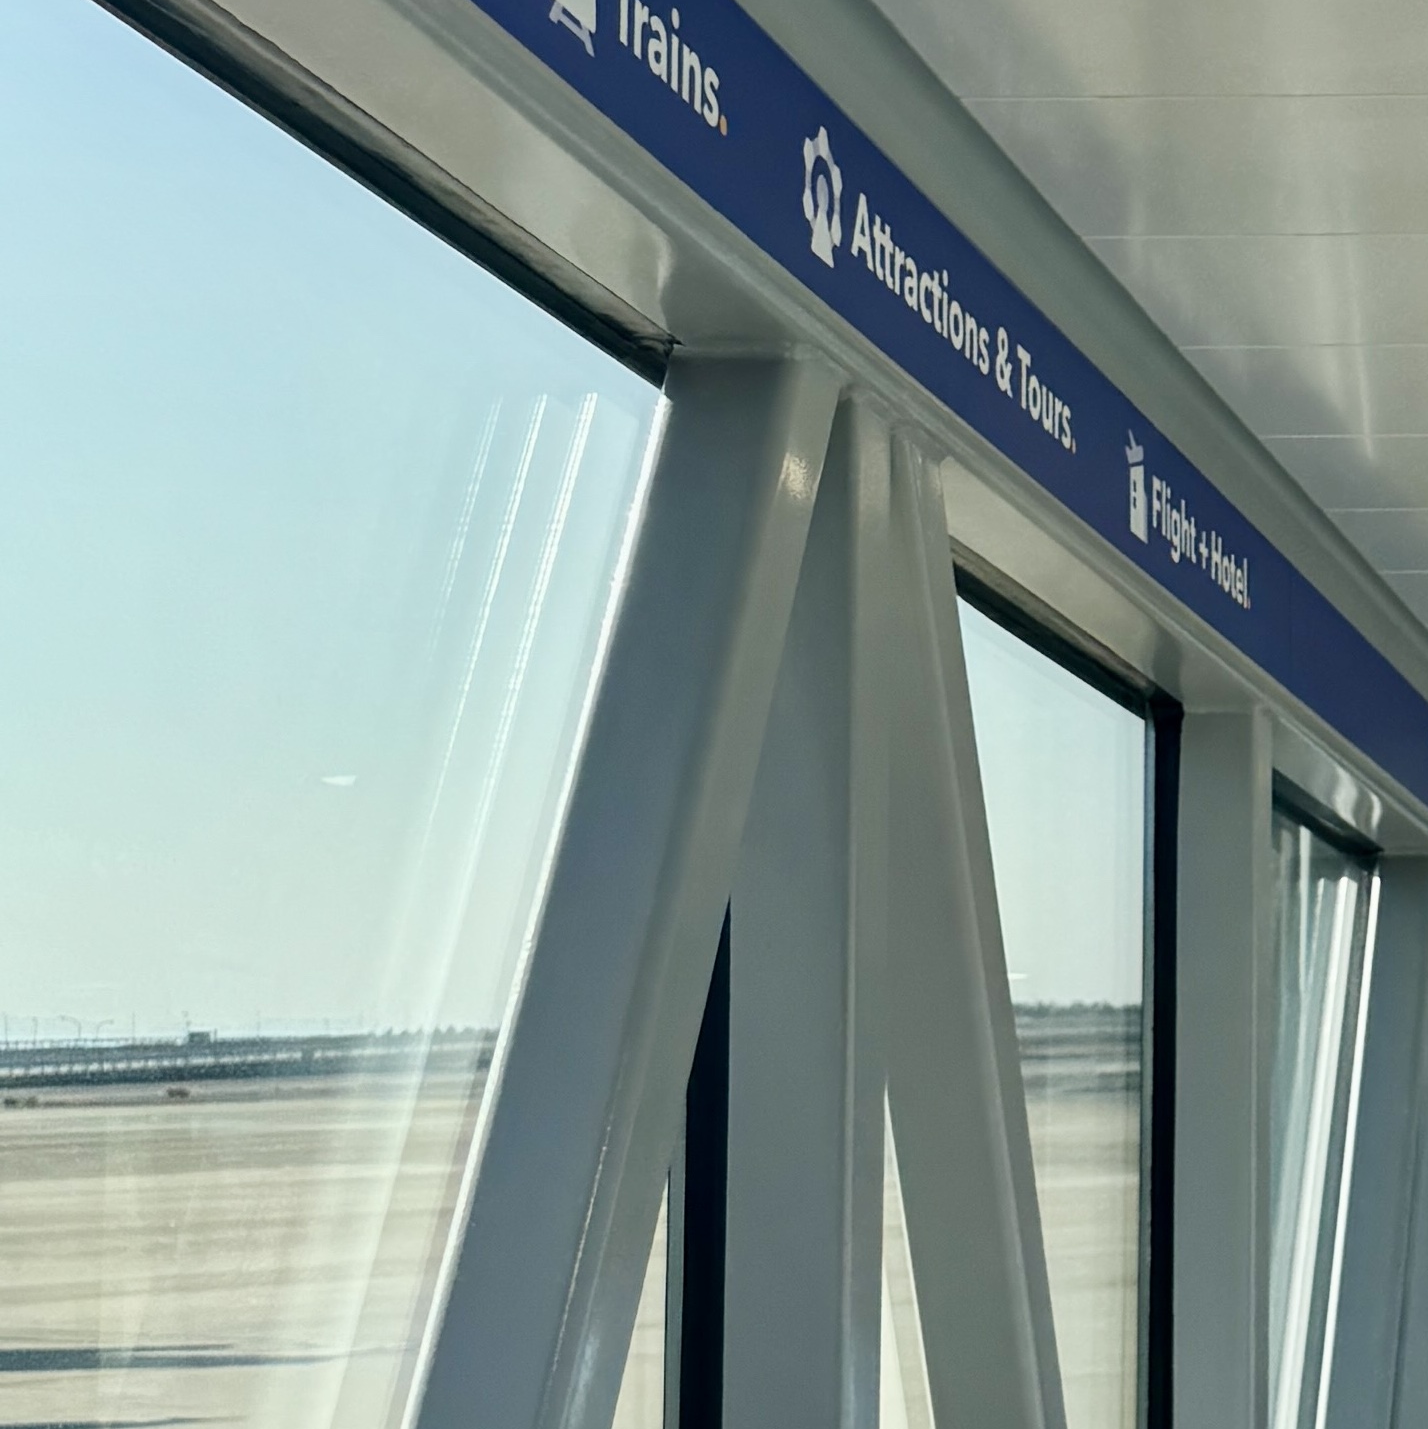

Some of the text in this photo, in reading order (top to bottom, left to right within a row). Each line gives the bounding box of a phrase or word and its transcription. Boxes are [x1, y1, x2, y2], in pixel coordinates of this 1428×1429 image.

[850, 192, 990, 376] Attractions
[995, 326, 1013, 399] &
[1152, 475, 1197, 564] Flight
